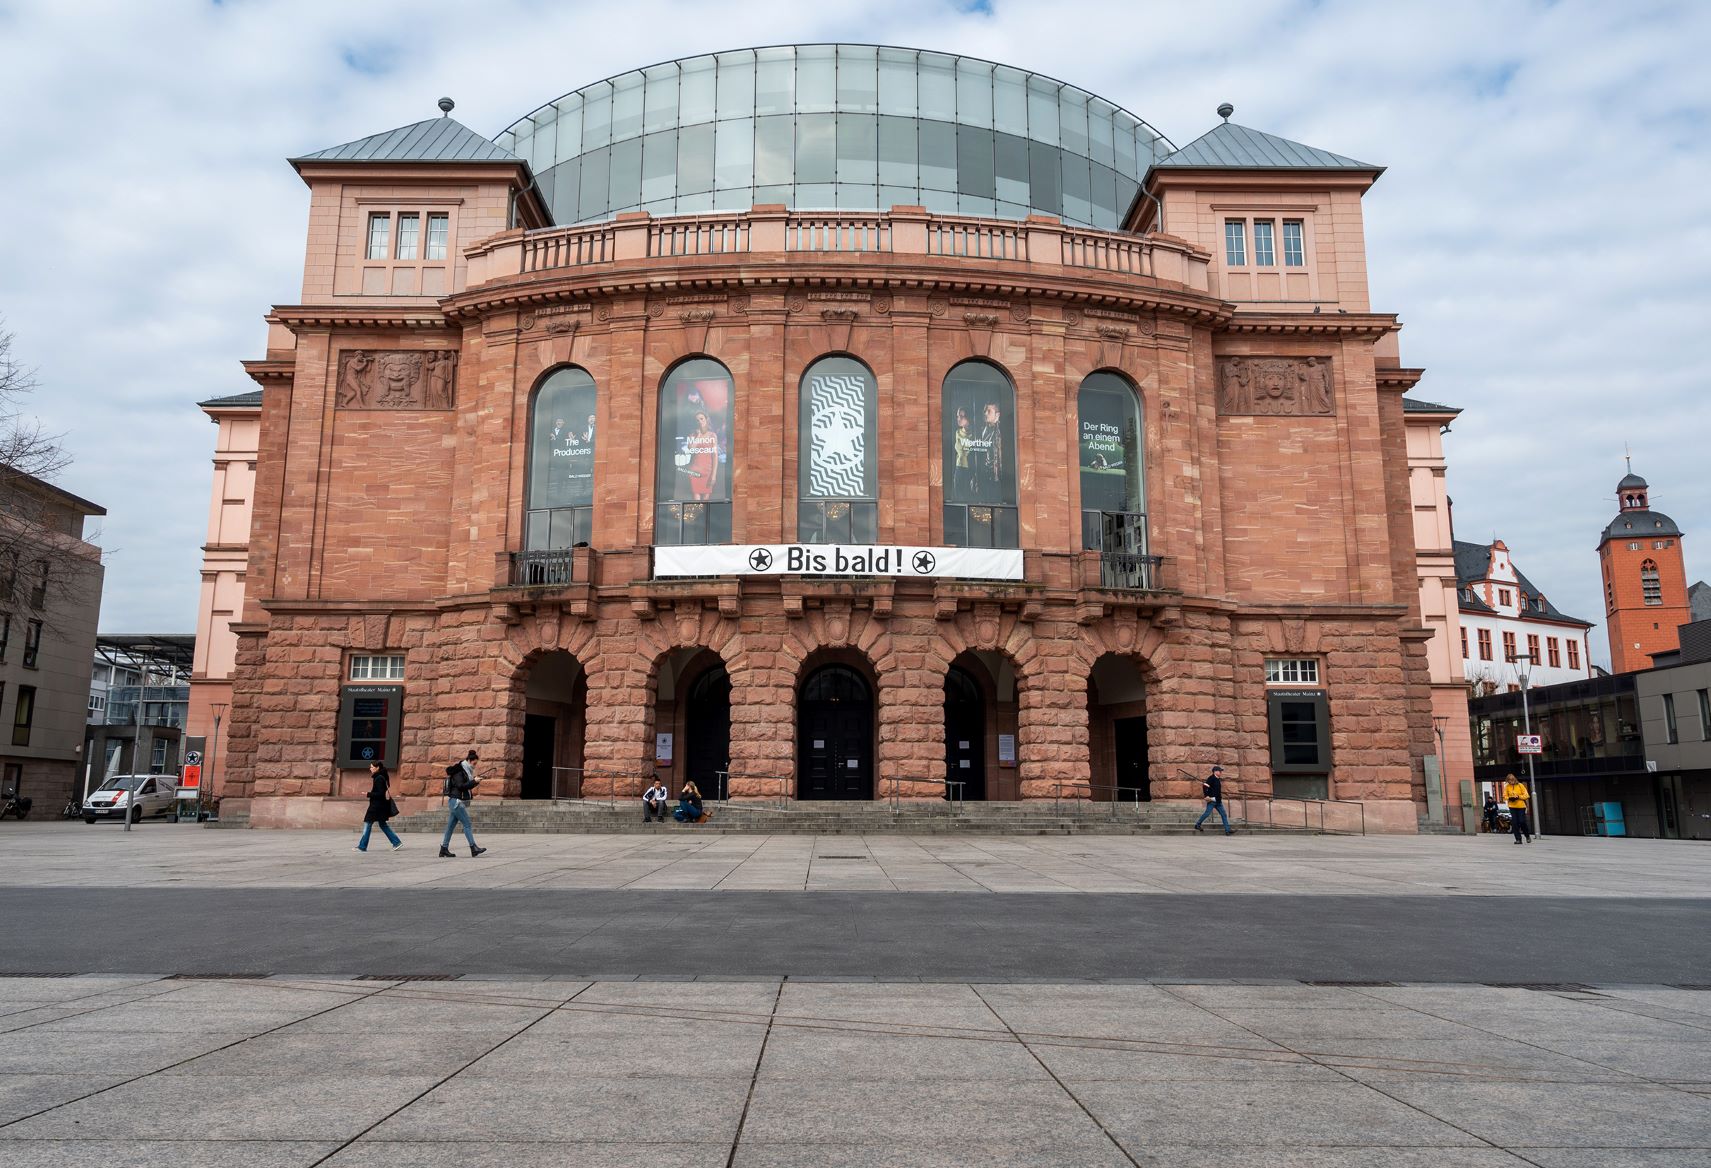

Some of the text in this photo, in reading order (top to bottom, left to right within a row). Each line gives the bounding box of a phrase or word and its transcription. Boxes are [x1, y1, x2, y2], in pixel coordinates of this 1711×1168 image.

[1083, 422, 1119, 434] Der Ring
[686, 436, 715, 444] Manon
[1083, 432, 1120, 442] an einem
[565, 438, 579, 446] The
[960, 438, 992, 447] Werther
[1088, 442, 1116, 452] Abend
[553, 448, 592, 457] Producers
[788, 546, 827, 572] Bis
